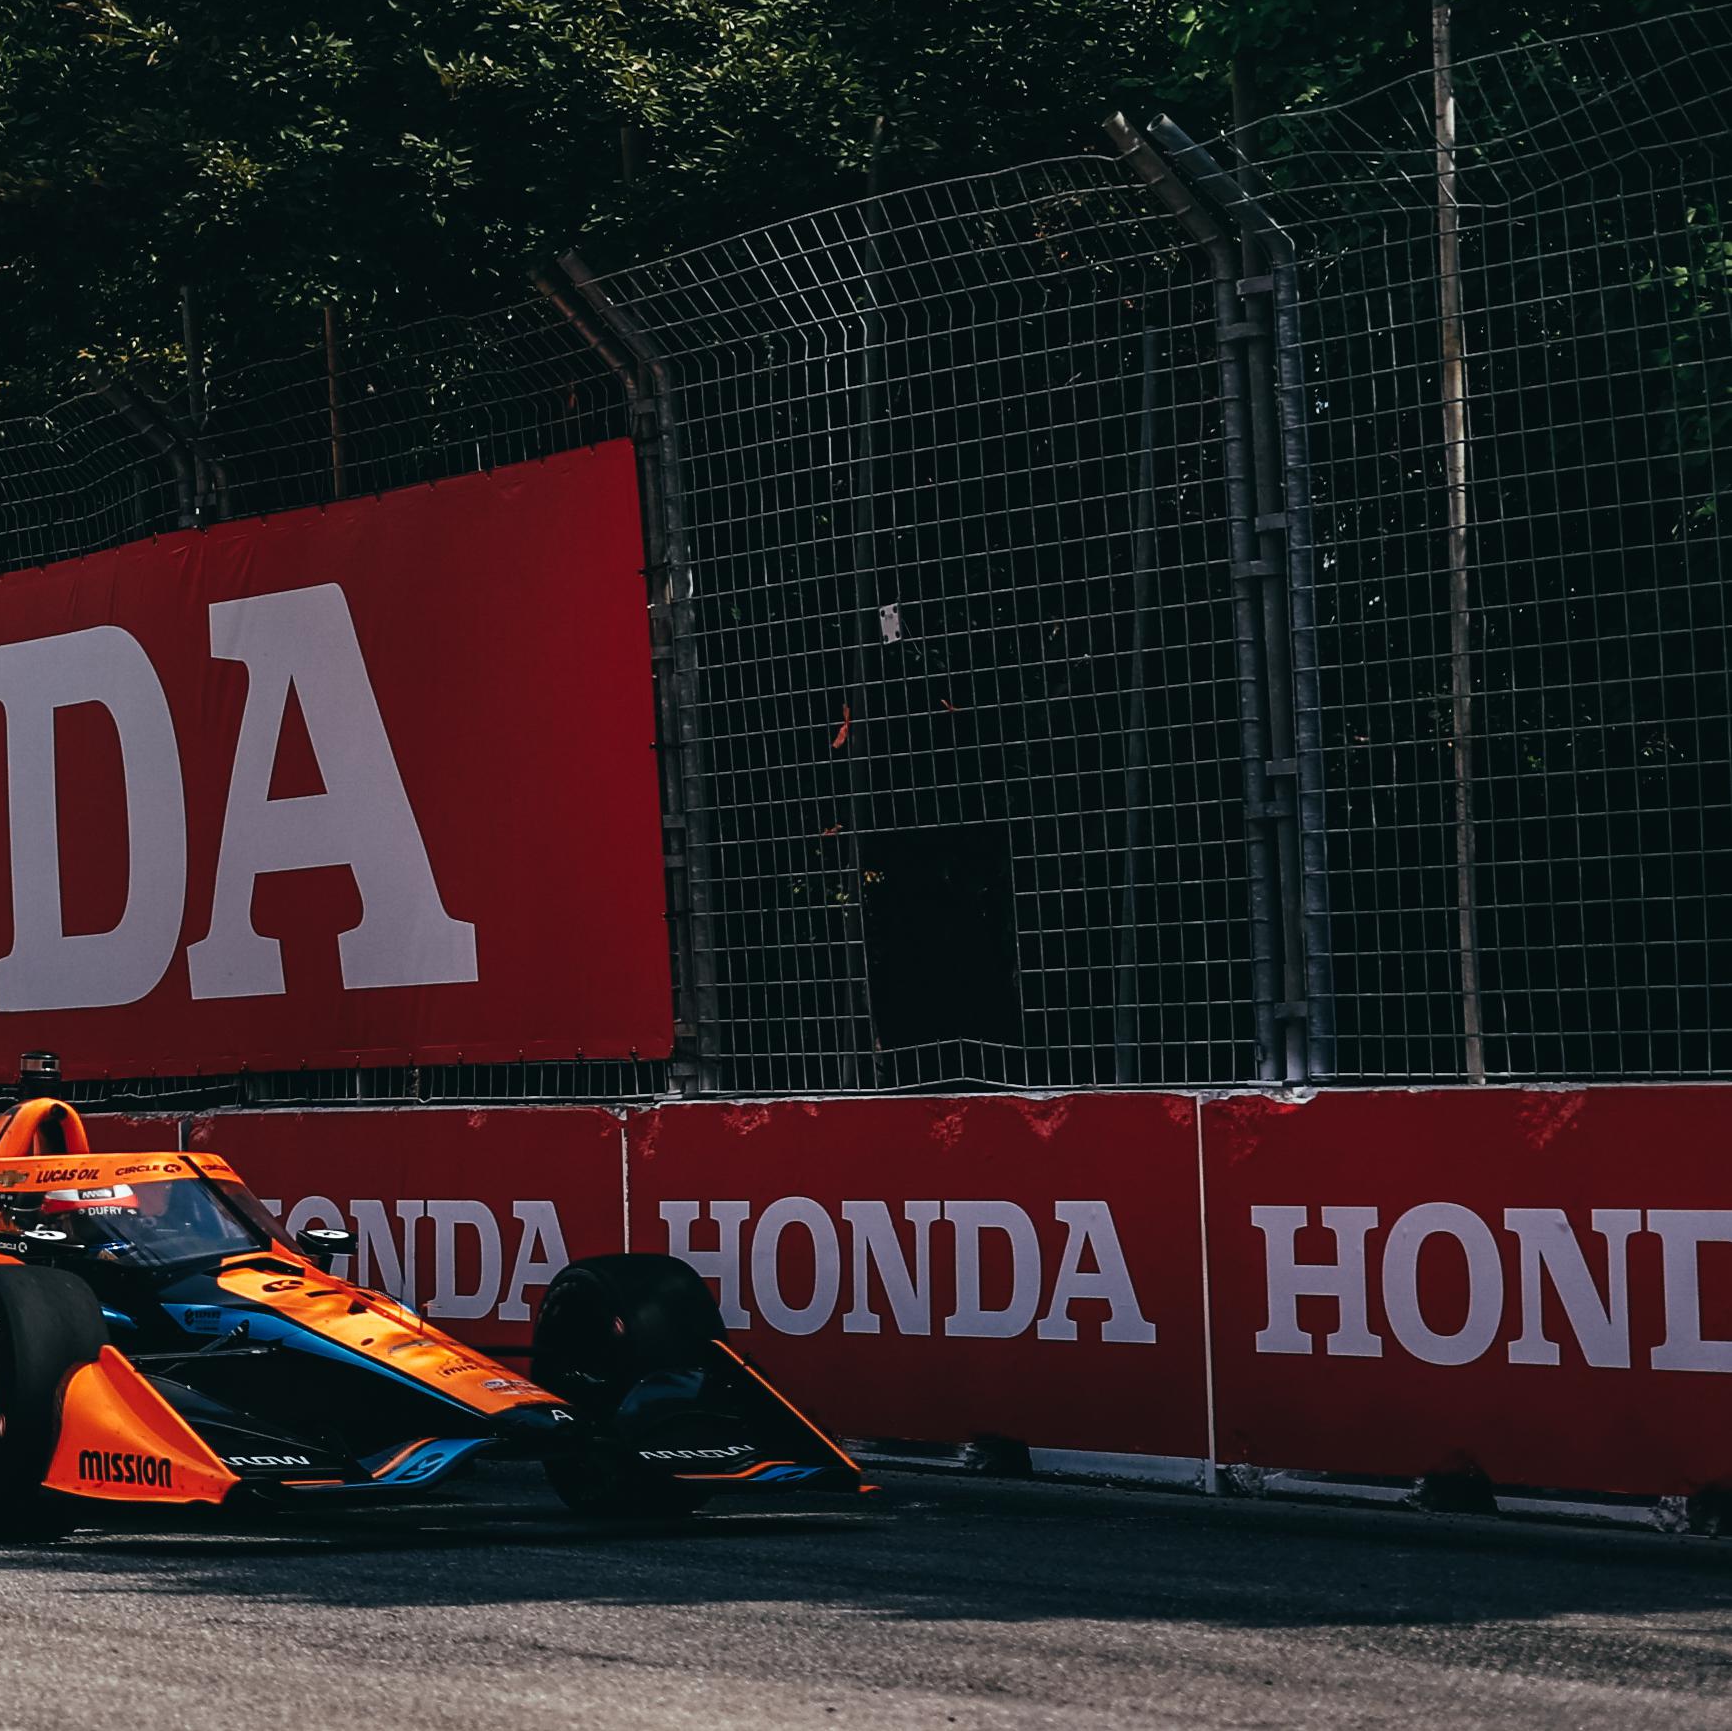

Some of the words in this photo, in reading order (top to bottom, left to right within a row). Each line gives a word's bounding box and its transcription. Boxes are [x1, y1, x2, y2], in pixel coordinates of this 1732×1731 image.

[35, 1170, 74, 1183] LUCAS
[77, 1168, 99, 1181] OIL
[88, 1206, 122, 1216] DUFRY
[260, 1195, 569, 1321] ONDA
[659, 1196, 1157, 1344] HONDA
